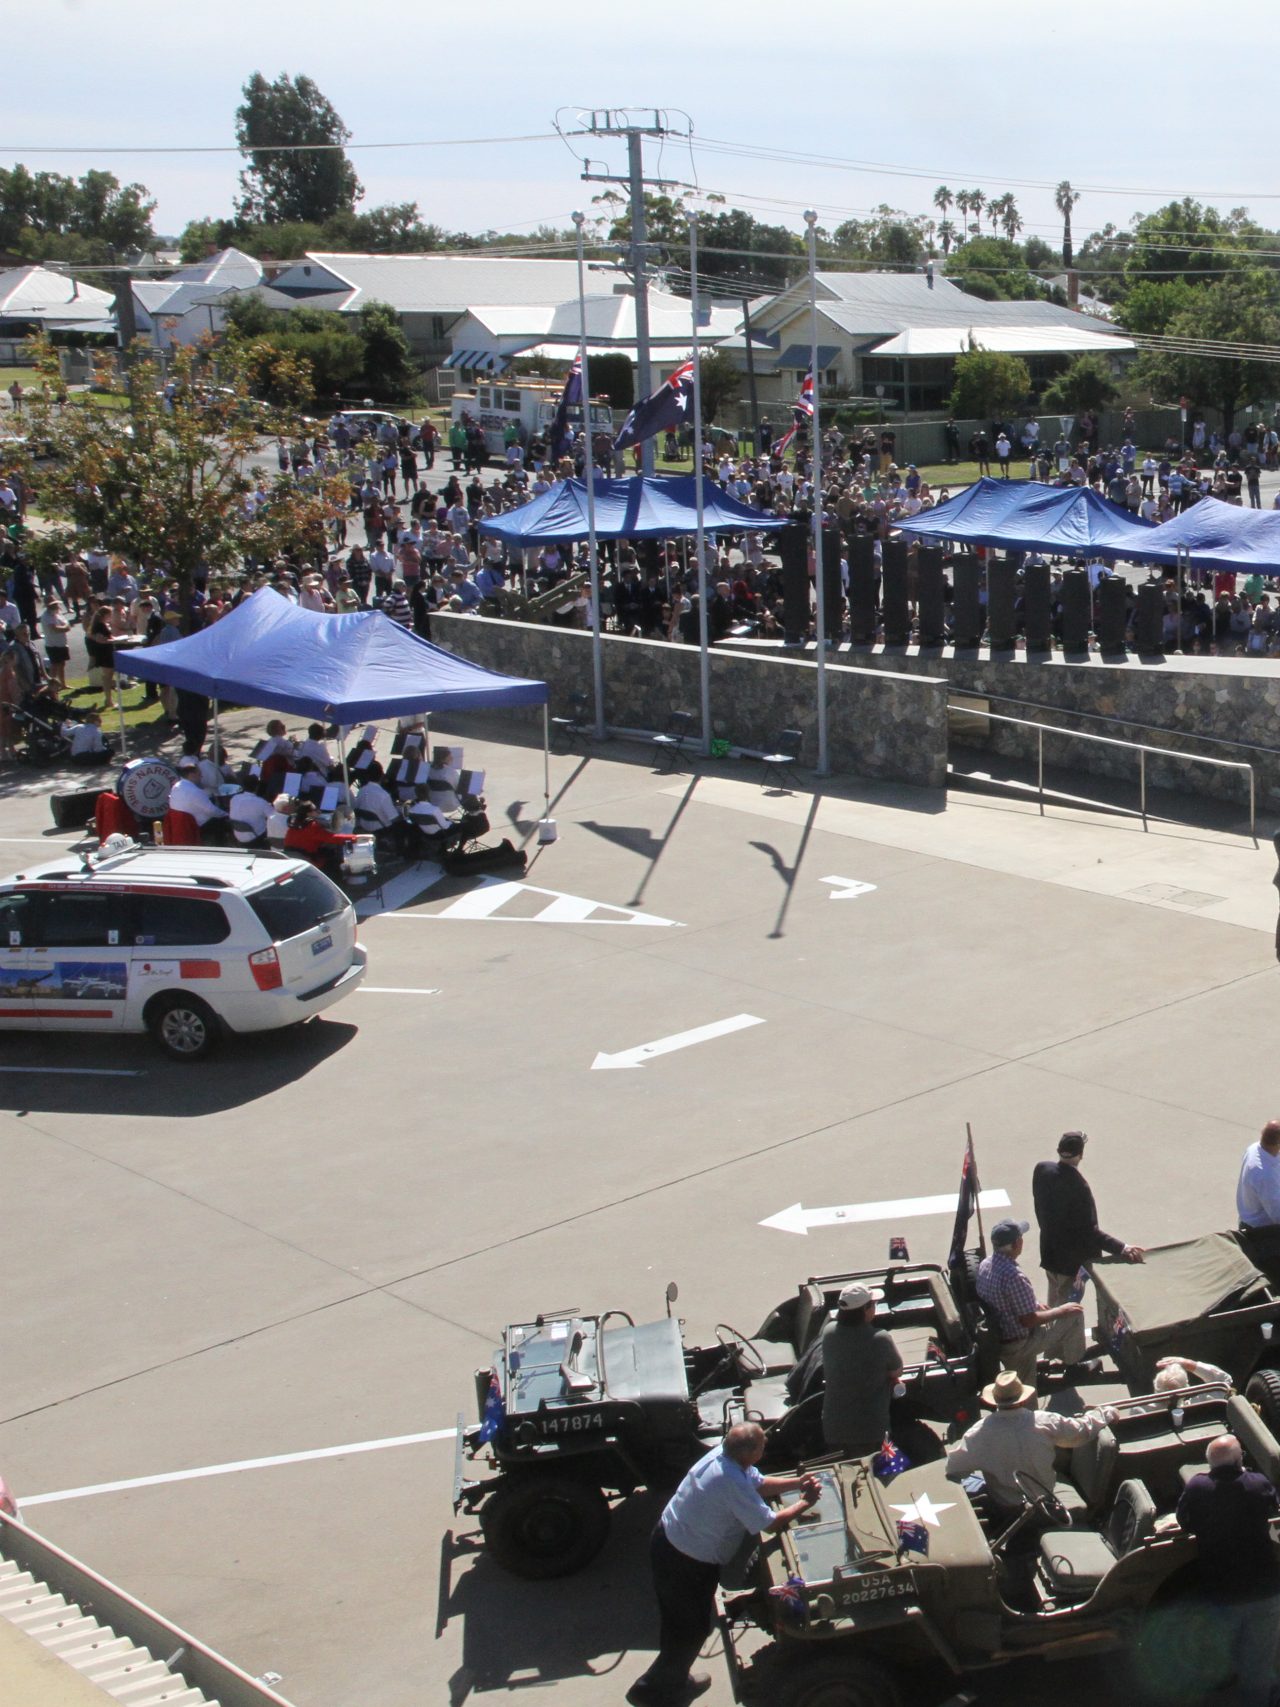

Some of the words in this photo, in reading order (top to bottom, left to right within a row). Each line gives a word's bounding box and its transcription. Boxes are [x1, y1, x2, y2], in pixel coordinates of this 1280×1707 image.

[113, 839, 128, 850] TAXI
[541, 1413, 603, 1434] 147874
[860, 1574, 892, 1588] USA
[842, 1582, 915, 1605] 20227634
